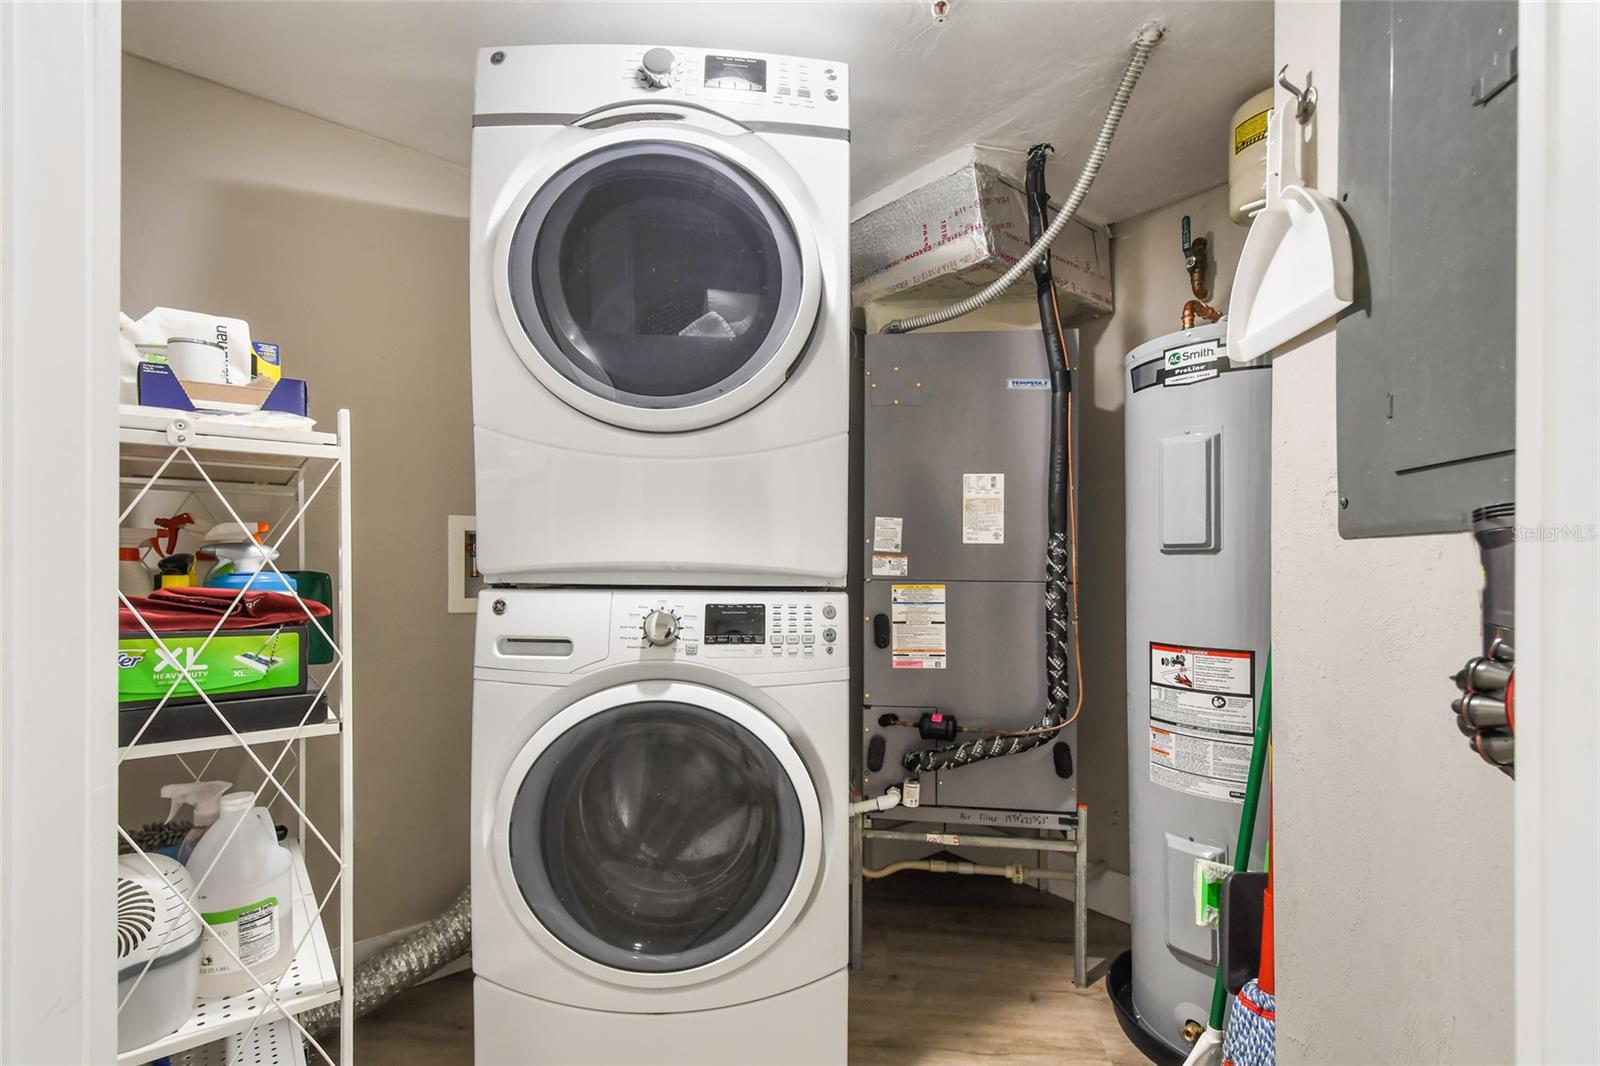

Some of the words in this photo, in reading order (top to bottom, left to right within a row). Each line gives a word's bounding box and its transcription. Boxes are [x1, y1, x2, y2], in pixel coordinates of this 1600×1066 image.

[1182, 348, 1214, 360] Smith
[1174, 364, 1207, 375] ProLine
[154, 647, 209, 672] XL
